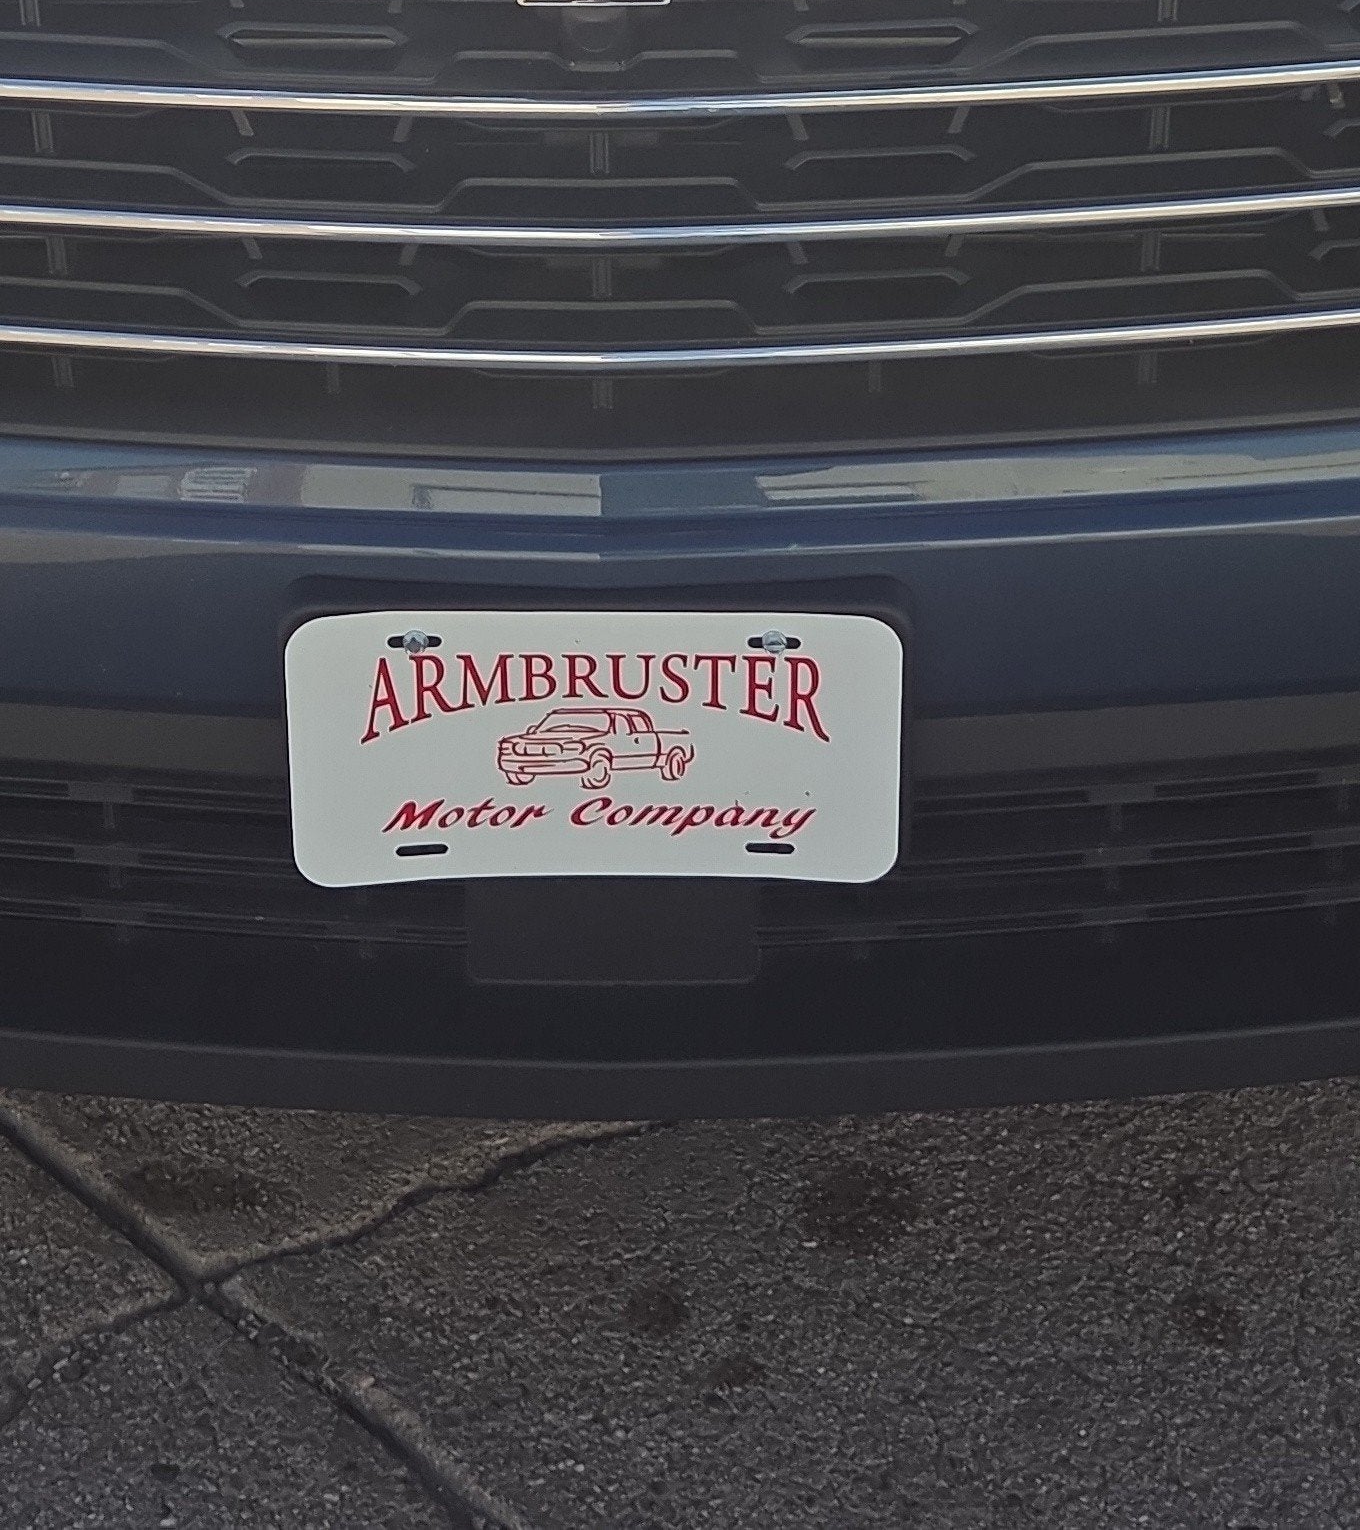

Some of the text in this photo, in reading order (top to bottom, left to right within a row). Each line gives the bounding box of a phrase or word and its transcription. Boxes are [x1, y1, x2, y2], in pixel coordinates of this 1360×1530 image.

[360, 653, 830, 743] ARMBRUSTER
[381, 796, 818, 840] Motor Company
